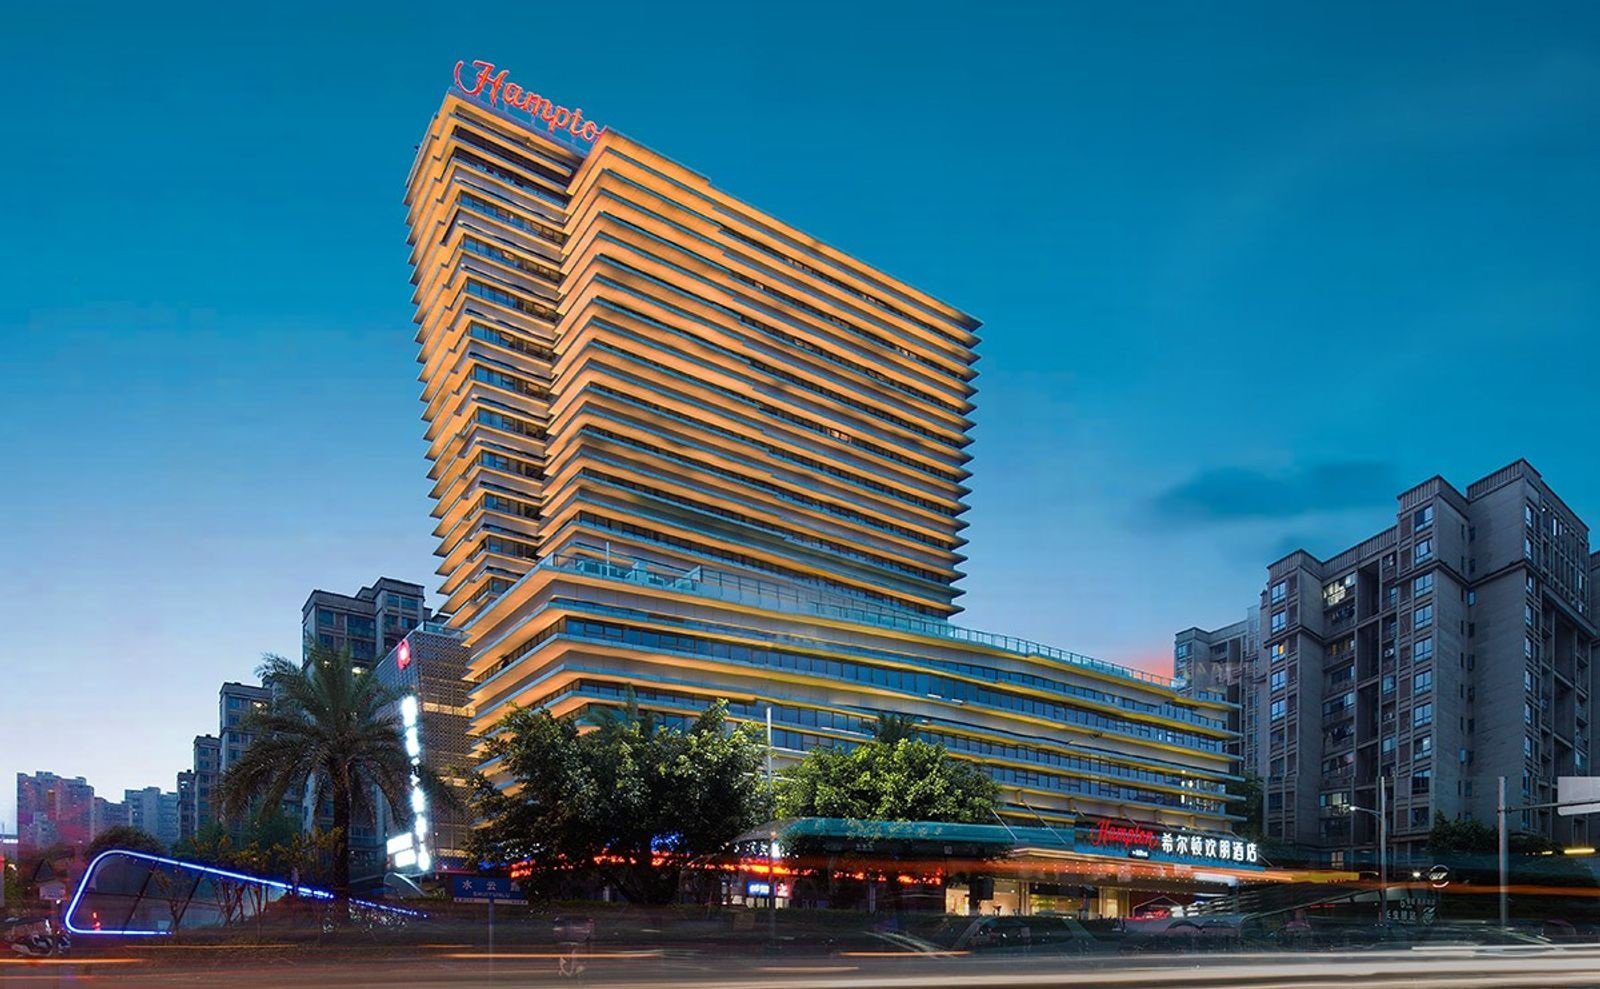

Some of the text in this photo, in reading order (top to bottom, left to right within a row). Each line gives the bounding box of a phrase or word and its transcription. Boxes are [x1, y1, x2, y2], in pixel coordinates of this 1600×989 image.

[453, 60, 607, 143] Hampto
[1089, 817, 1159, 848] Hampton
[1161, 832, 1257, 863] 希尔顿欢朋酒店
